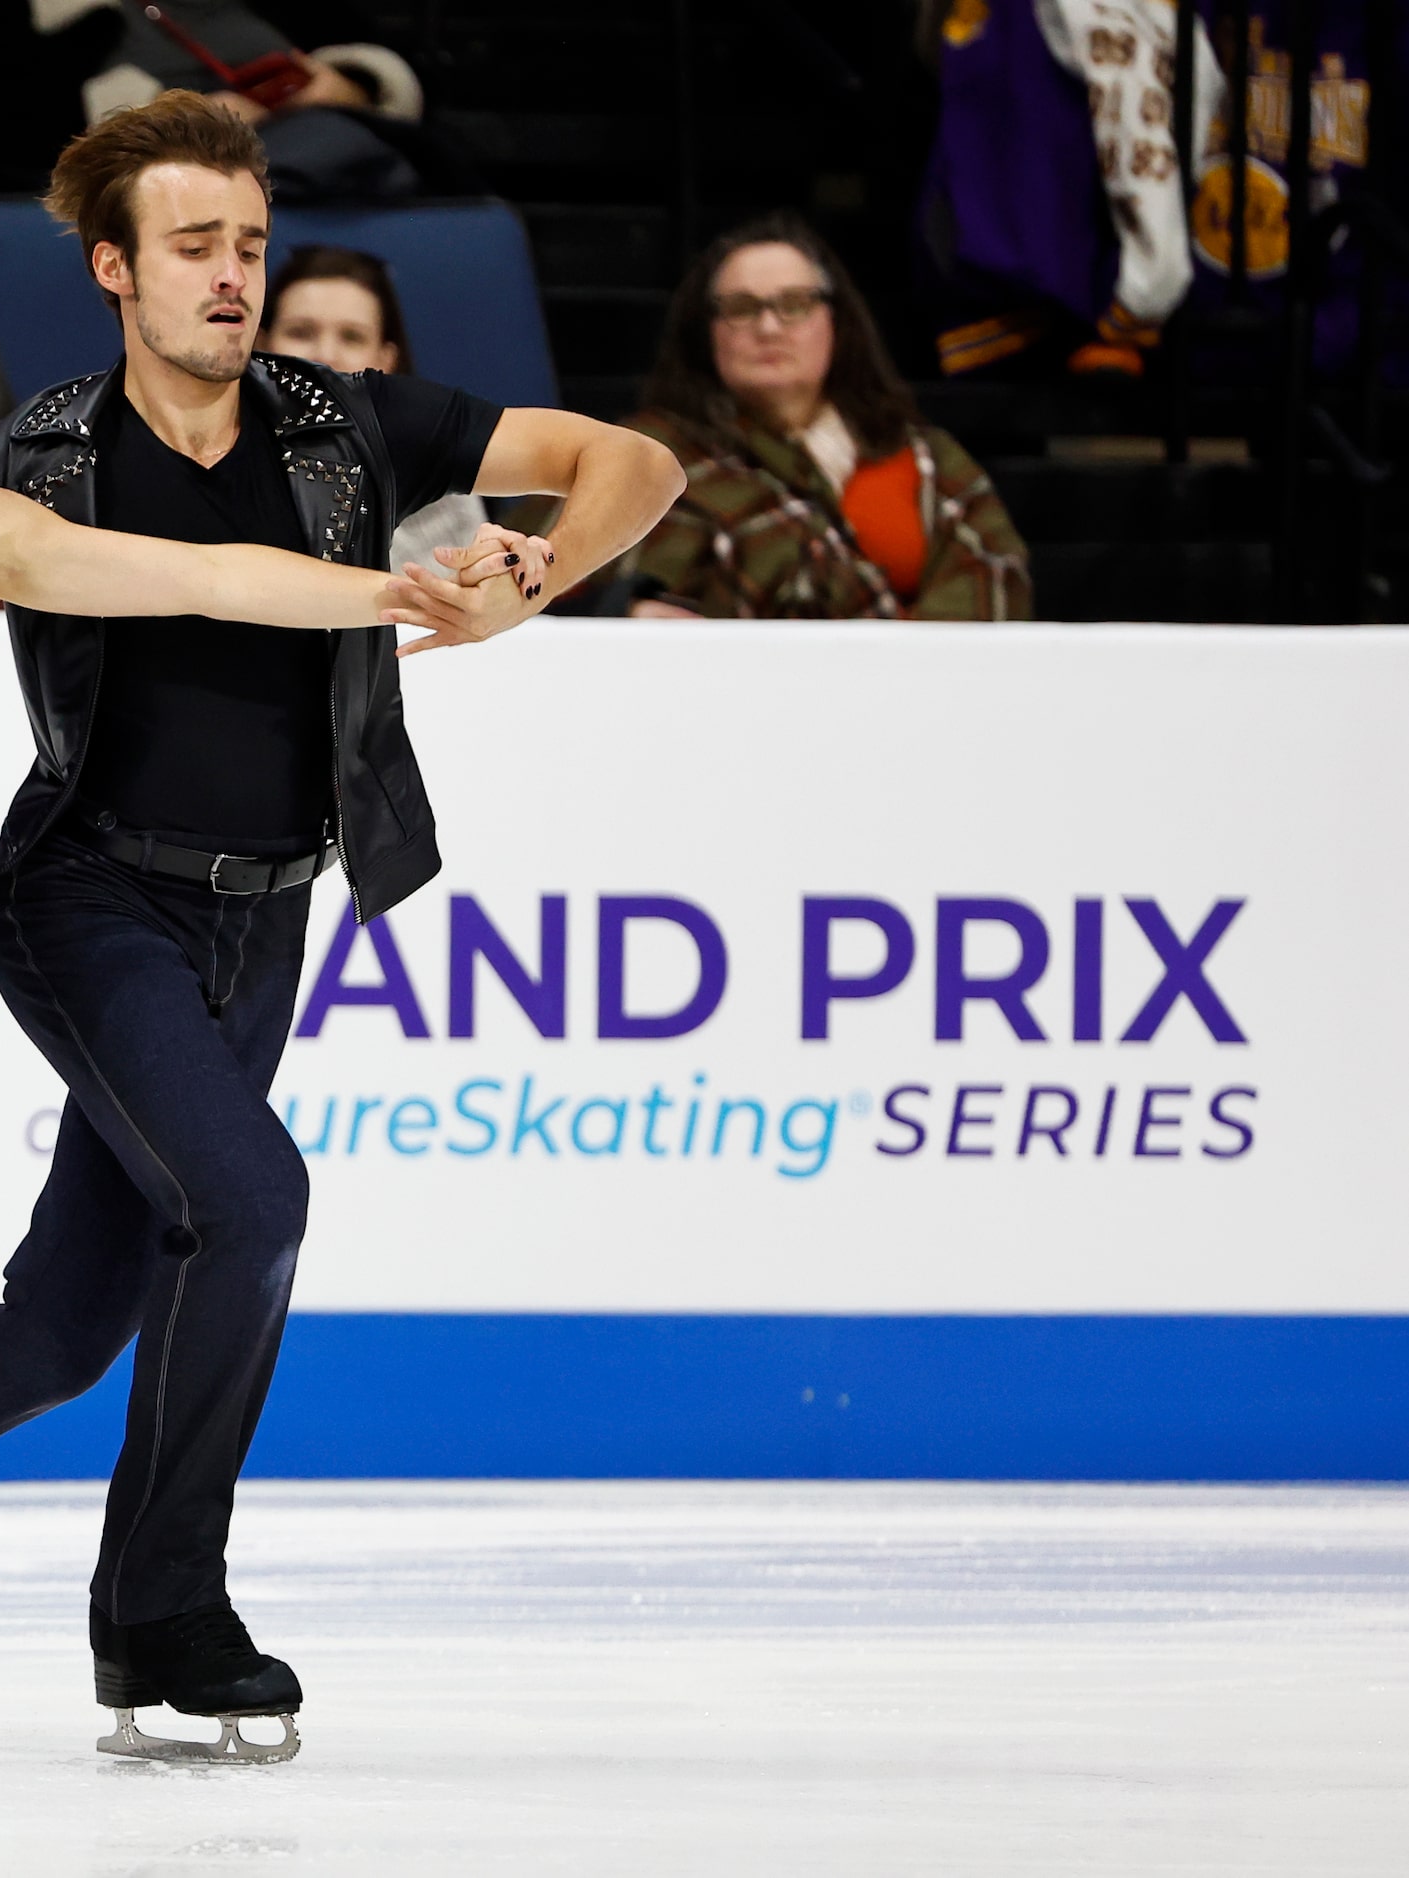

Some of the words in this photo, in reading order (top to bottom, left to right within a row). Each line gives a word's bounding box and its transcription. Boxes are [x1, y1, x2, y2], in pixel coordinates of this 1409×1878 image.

[294, 894, 728, 1040] AND
[801, 895, 1248, 1044] PRIX
[280, 1073, 839, 1180] ureSkating
[875, 1083, 1259, 1161] SERIES
